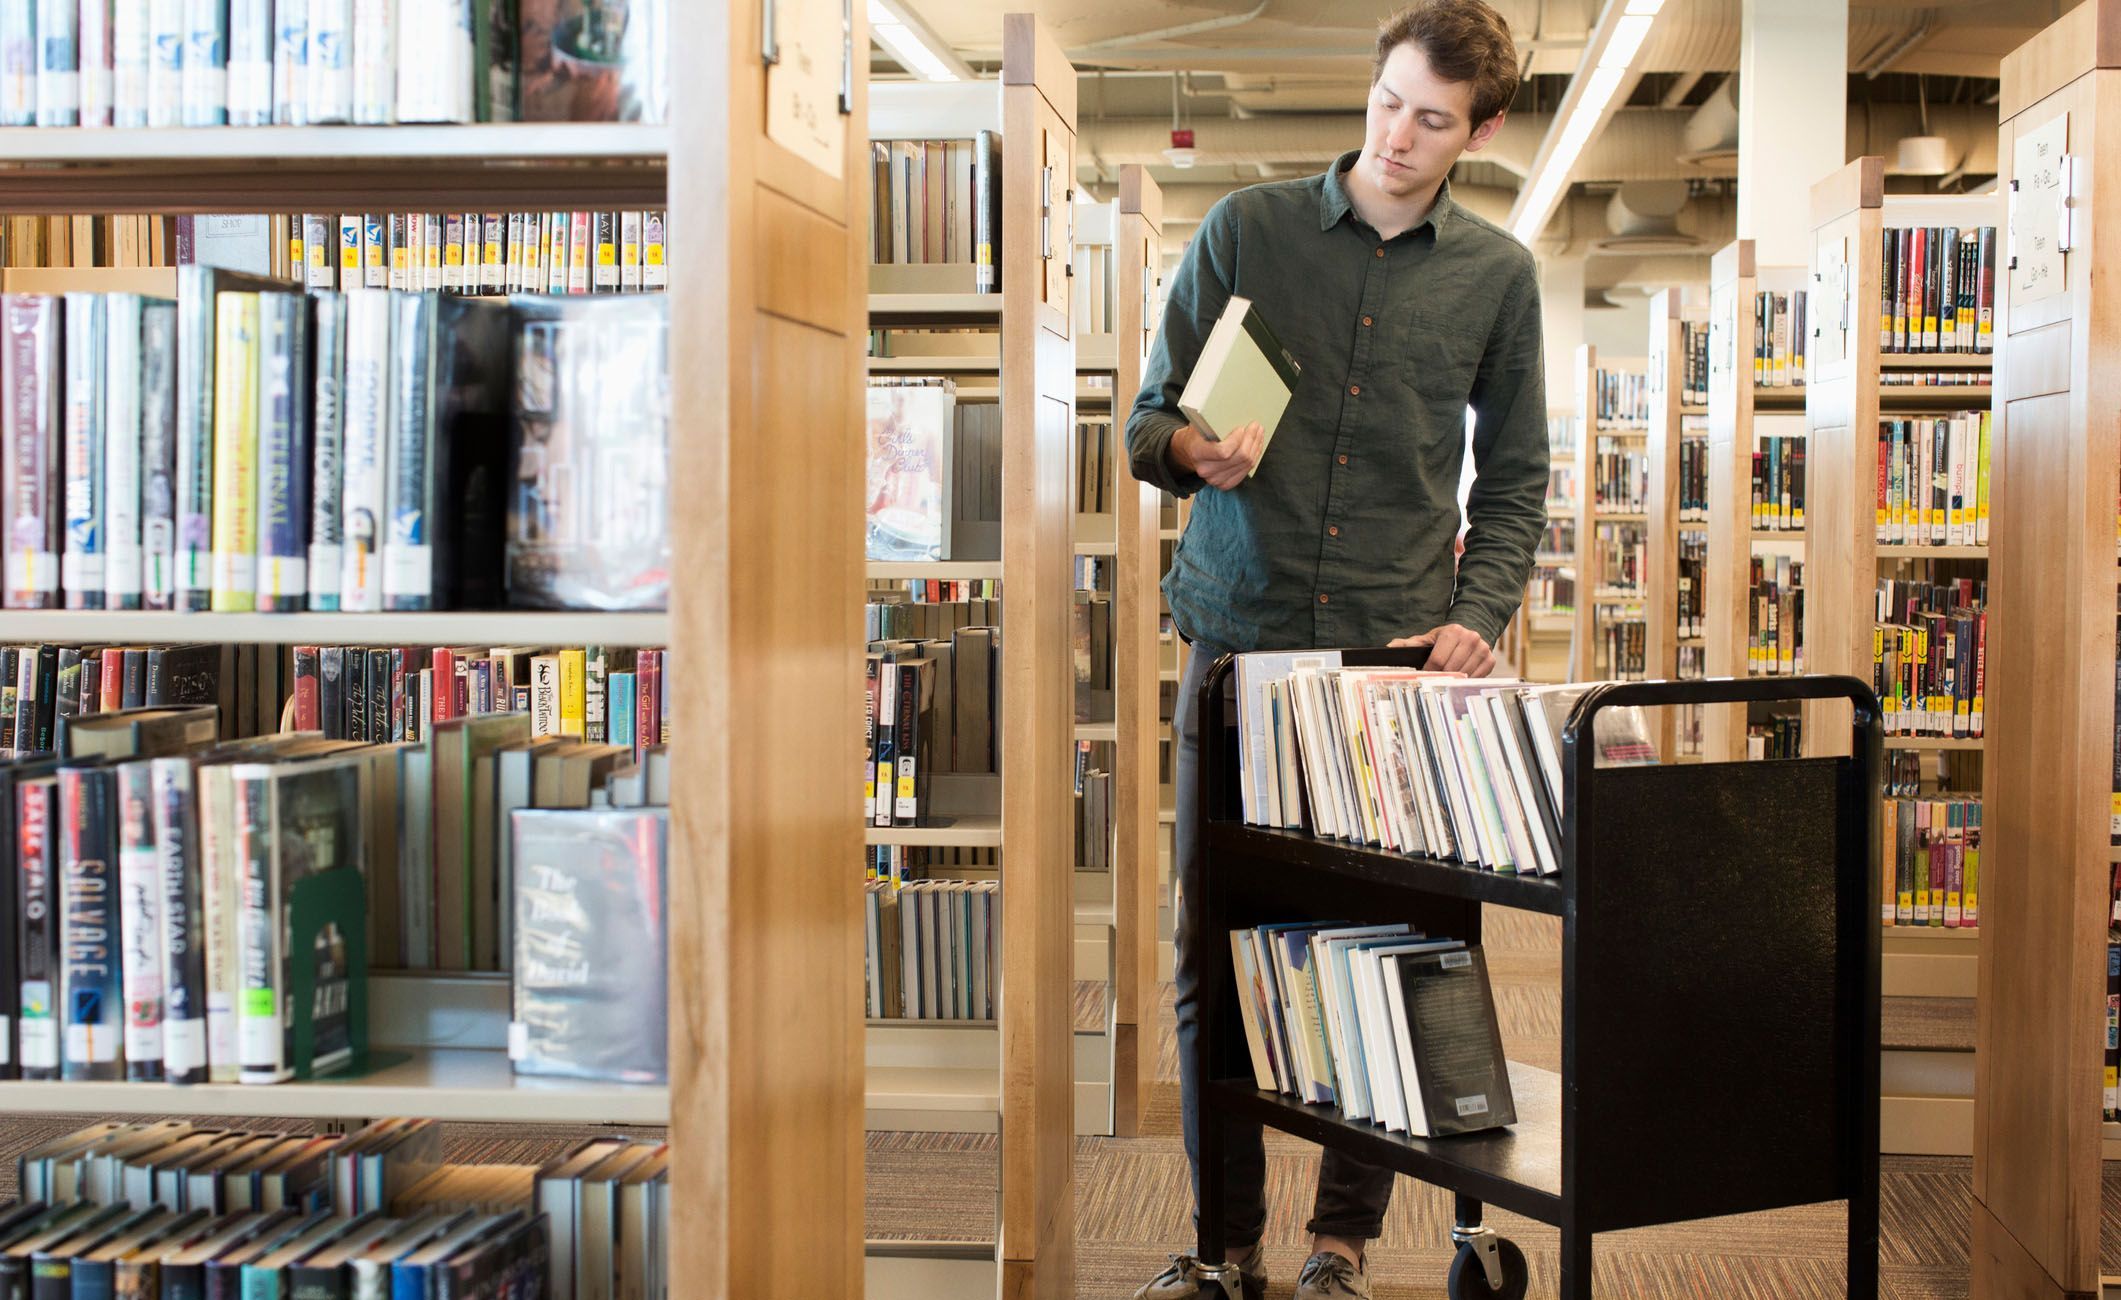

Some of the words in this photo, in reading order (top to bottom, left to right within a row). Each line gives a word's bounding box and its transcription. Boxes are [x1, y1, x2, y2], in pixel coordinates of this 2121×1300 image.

[268, 419, 290, 526] ETERNAL
[1878, 463, 1886, 501] DRAGON
[640, 694, 652, 710] Girl
[641, 683, 650, 694] The
[1976, 671, 1985, 688] FALL
[438, 696, 446, 713] THE
[163, 826, 184, 897] EARTH
[26, 862, 48, 920] HALO
[66, 858, 108, 977] SALVAGE
[167, 900, 187, 955] STAR
